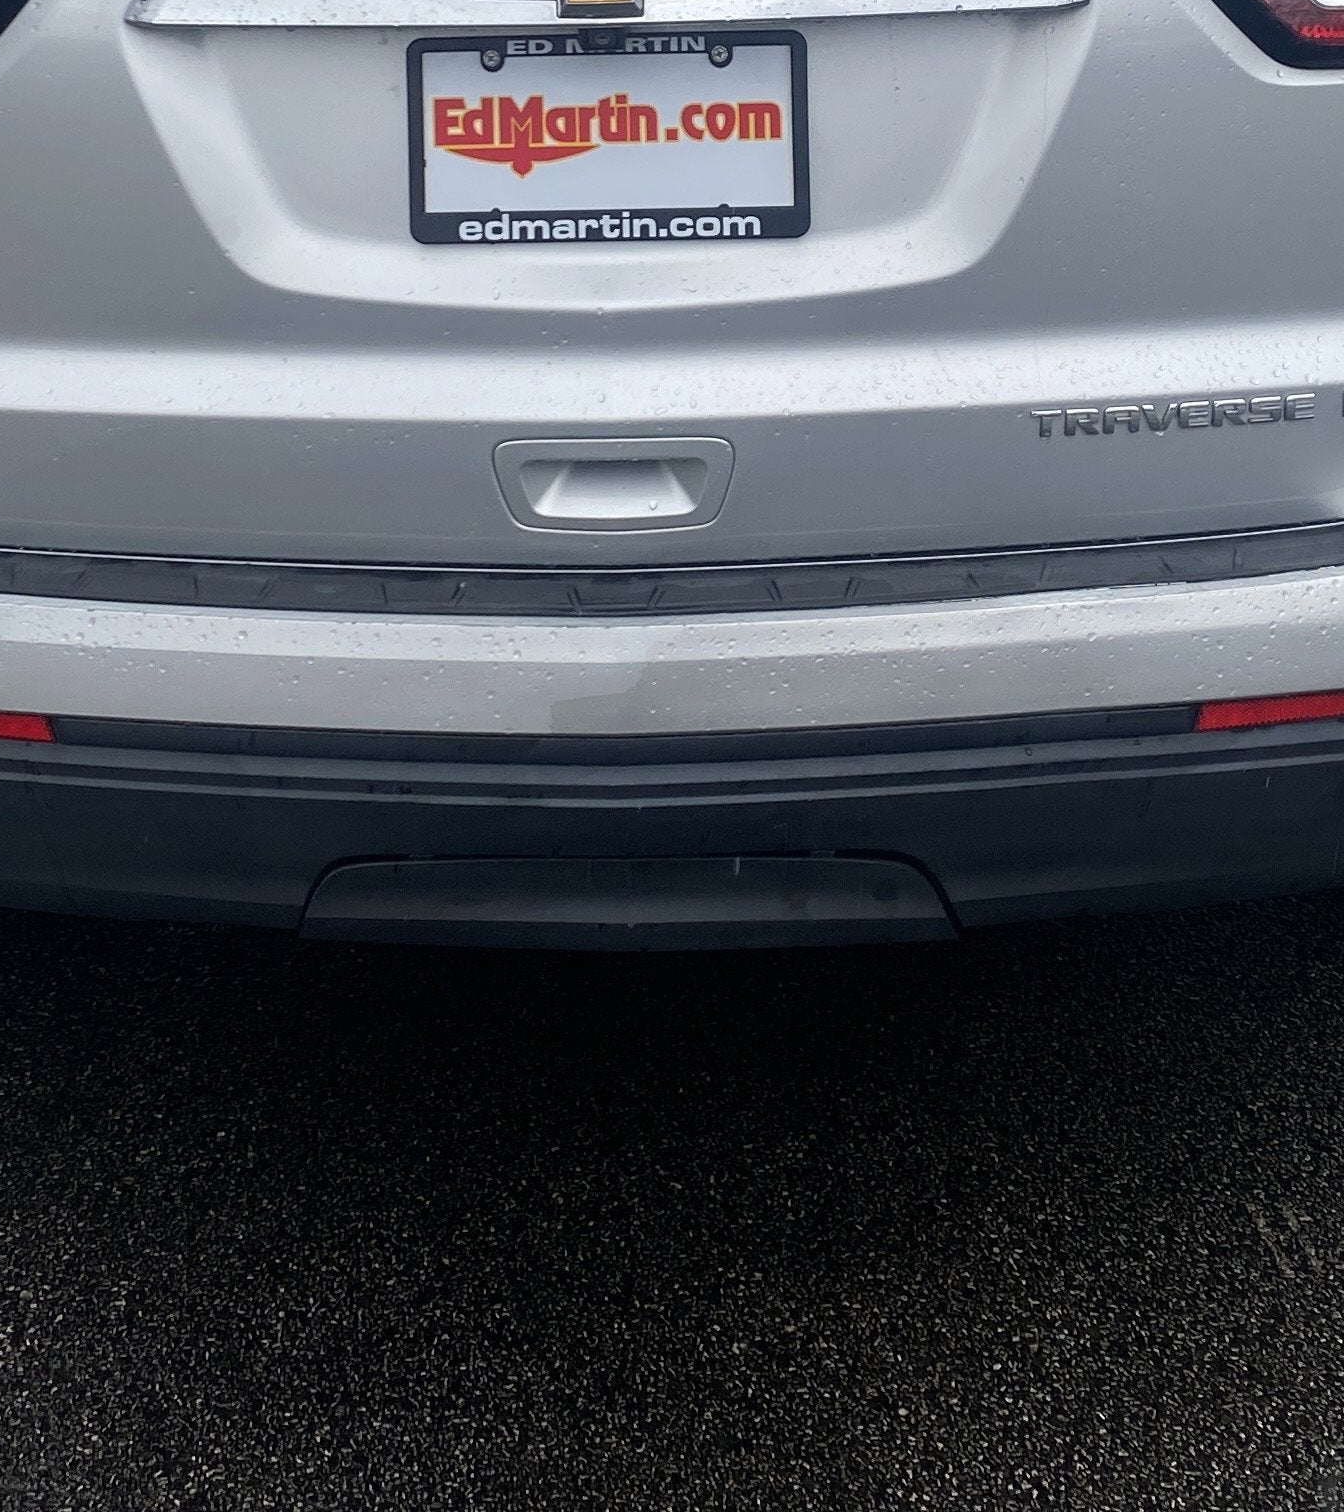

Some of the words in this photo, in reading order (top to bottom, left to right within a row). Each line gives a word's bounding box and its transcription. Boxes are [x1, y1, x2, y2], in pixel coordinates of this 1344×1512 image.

[506, 39, 553, 56] ED
[566, 35, 706, 55] MRTIN
[432, 92, 783, 150] EdMartin.com
[458, 211, 762, 241] edmartin.com
[1030, 392, 1316, 438] TRAVERSE
